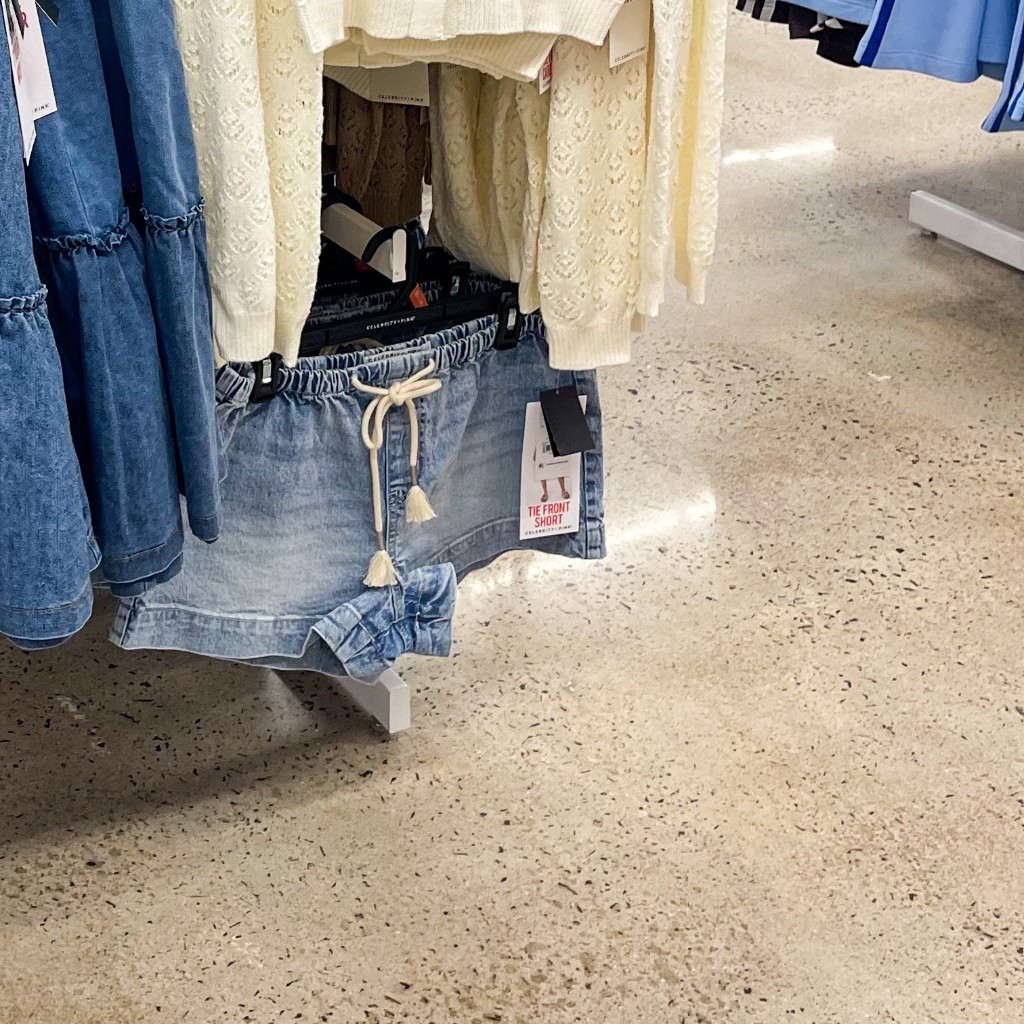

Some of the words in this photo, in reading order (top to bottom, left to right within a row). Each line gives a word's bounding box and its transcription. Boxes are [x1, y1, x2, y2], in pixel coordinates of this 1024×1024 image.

[528, 506, 541, 517] TIE
[543, 501, 570, 516] FRONT
[535, 514, 563, 528] SHORT
